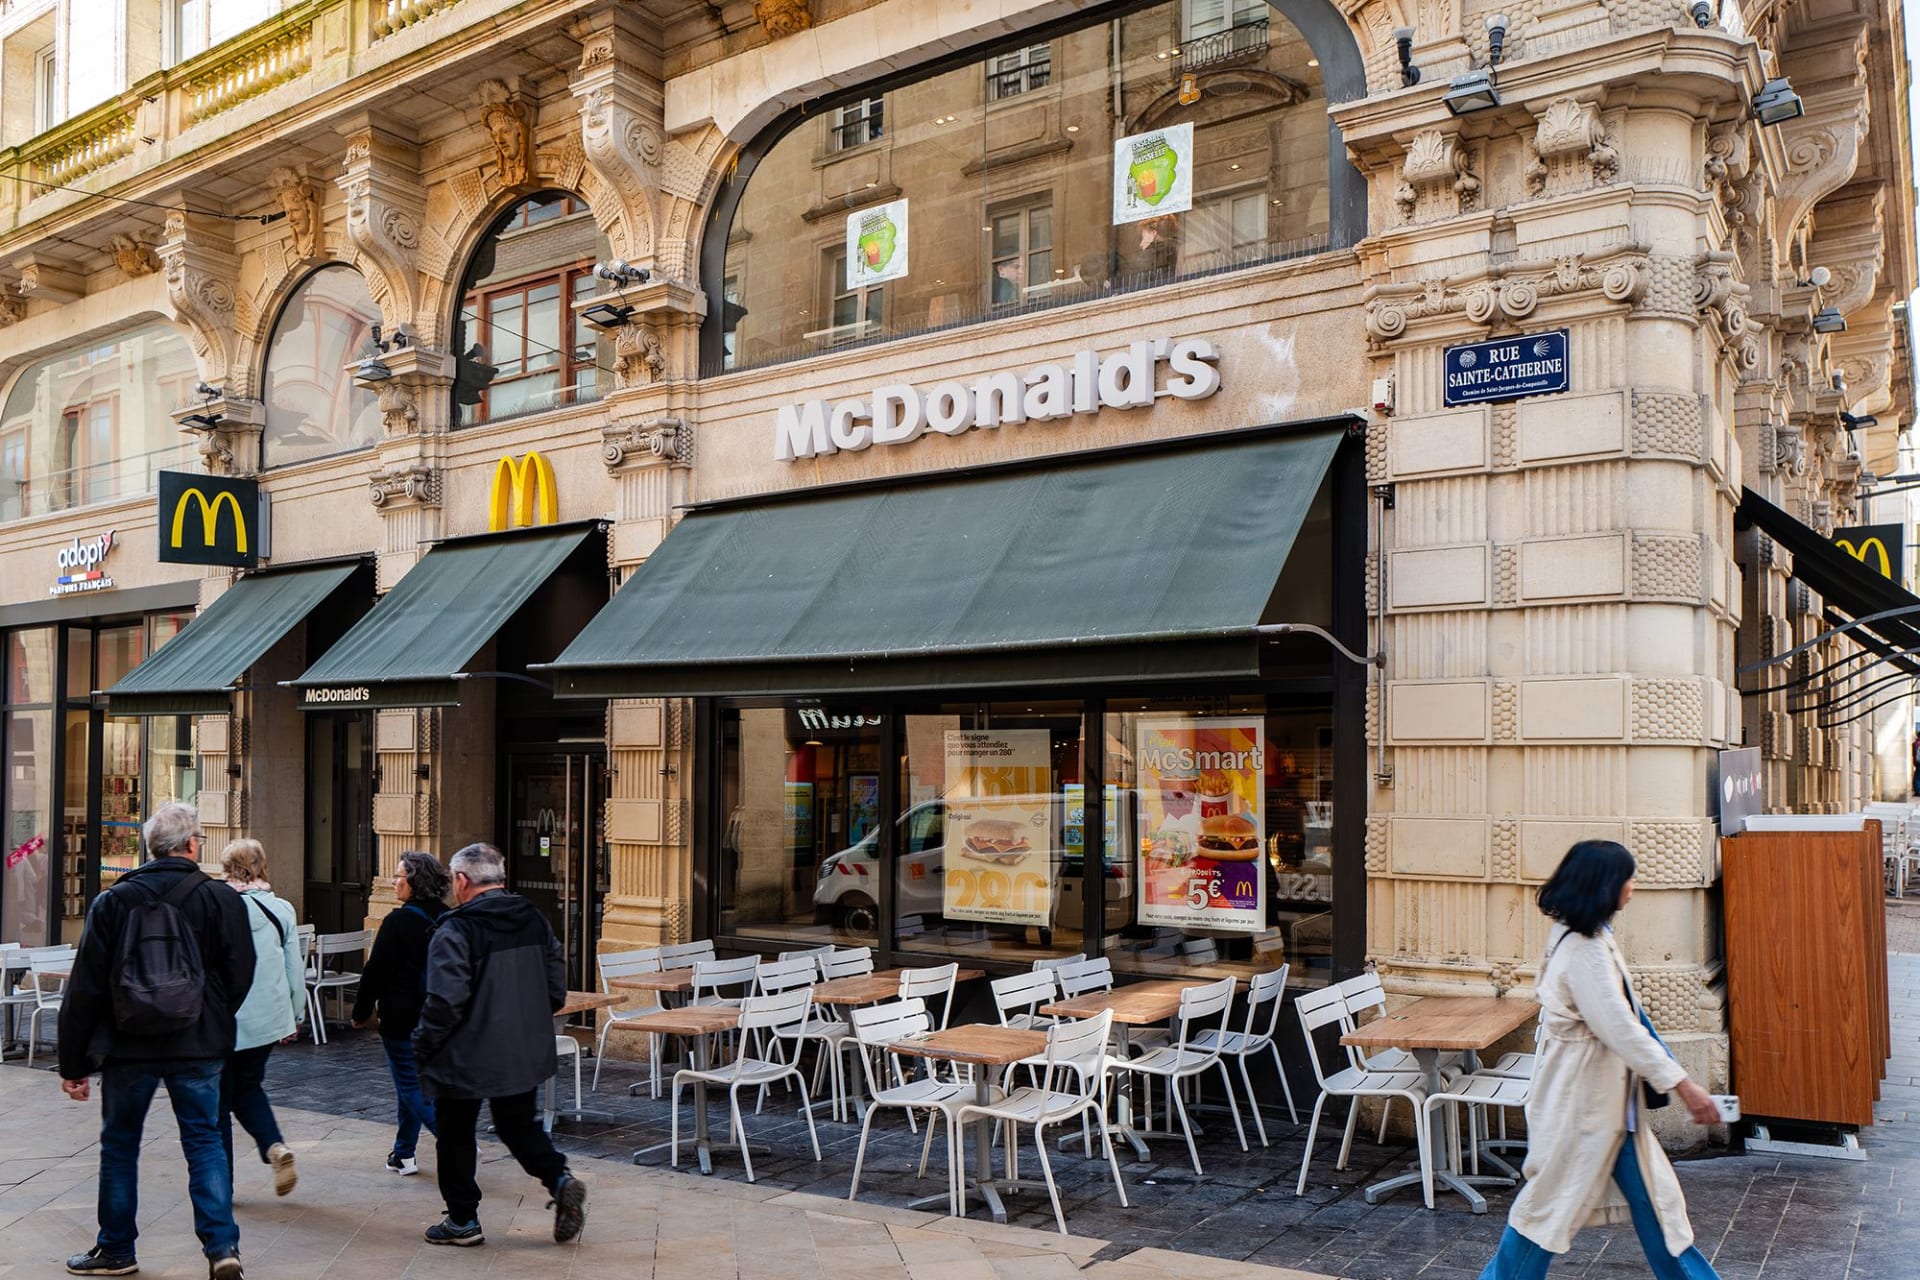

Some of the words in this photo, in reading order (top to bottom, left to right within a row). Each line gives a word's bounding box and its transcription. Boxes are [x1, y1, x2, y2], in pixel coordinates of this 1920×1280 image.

[1489, 345, 1520, 364] RUE
[1449, 358, 1562, 388] SAINTE-CATHERINE
[774, 337, 1222, 463] McDonald's
[305, 686, 370, 703] McDonald's
[971, 732, 989, 742] signe
[977, 740, 1008, 749] attendiez
[947, 750, 963, 758] pour
[963, 750, 989, 758] manger
[1139, 745, 1263, 771] McSmart
